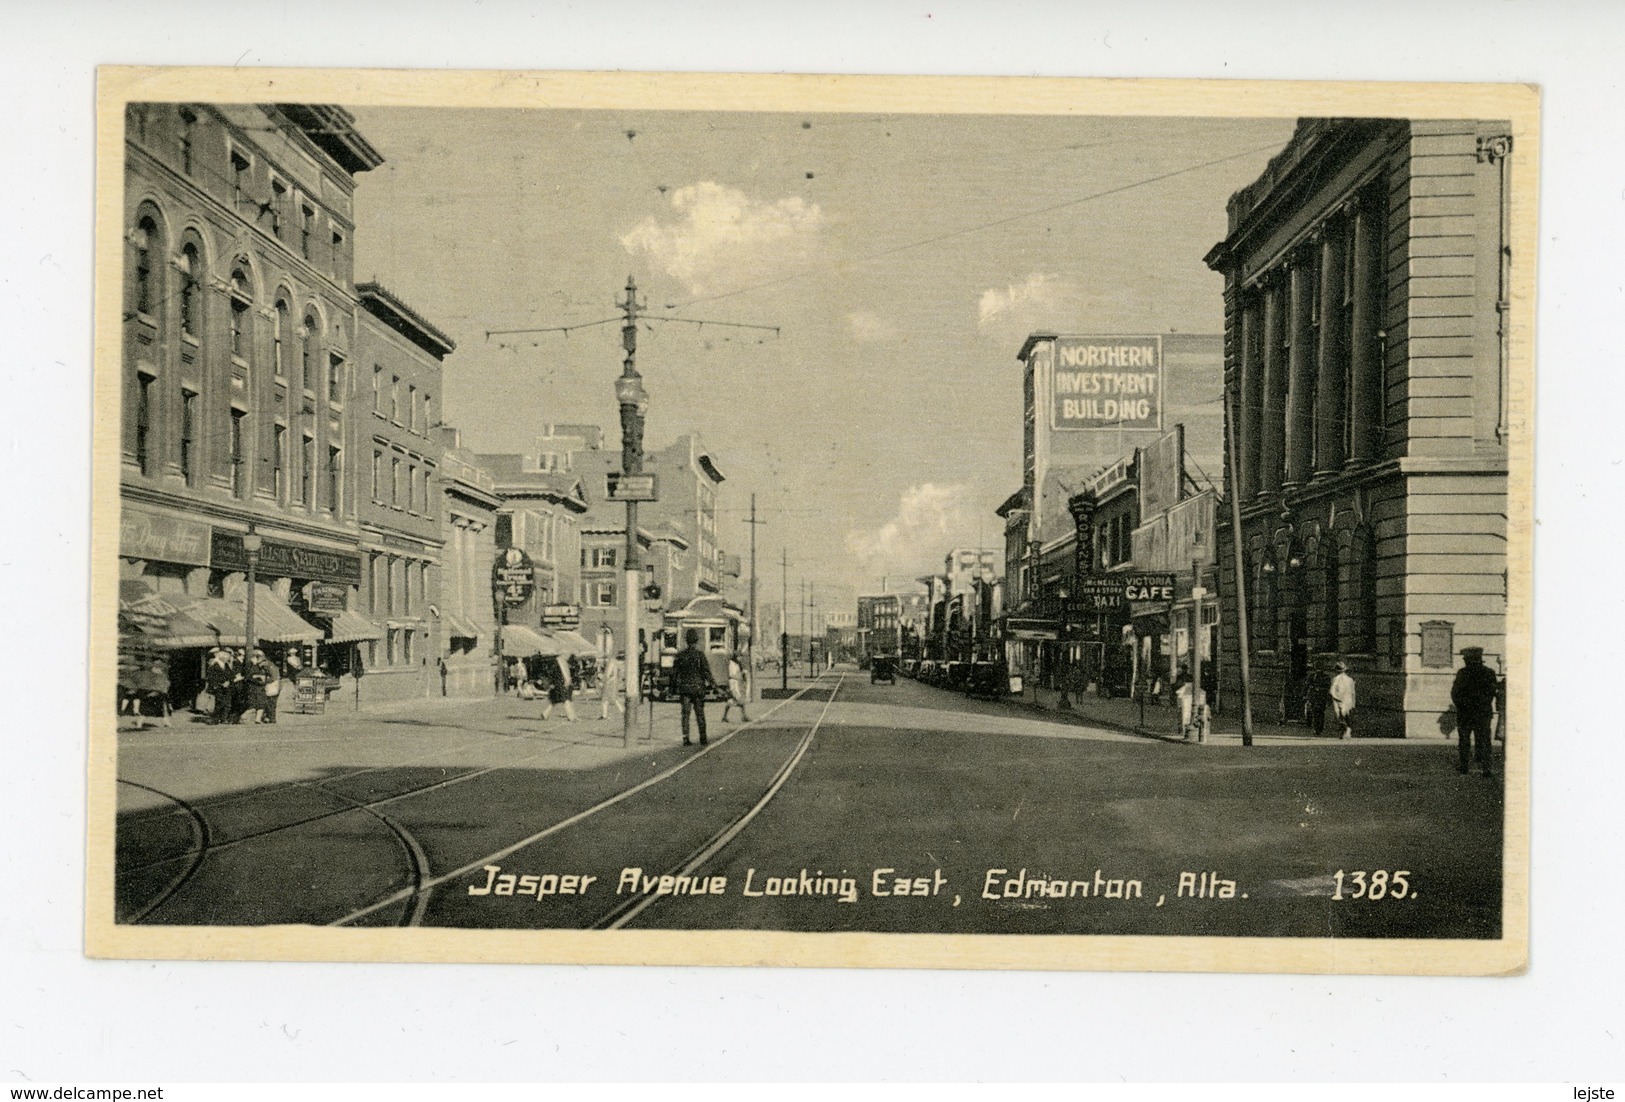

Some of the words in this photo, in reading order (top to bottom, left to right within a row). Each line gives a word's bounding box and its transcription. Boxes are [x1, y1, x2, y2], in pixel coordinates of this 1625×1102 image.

[1060, 345, 1154, 367] NORTHERN
[1056, 371, 1157, 394] INVESTMENT
[1062, 398, 1150, 420] BUILDING
[1030, 541, 1041, 601] CAPITOL
[1125, 576, 1172, 586] VICTORIA
[1093, 595, 1121, 607] TAXI
[1125, 585, 1174, 600] CAFE
